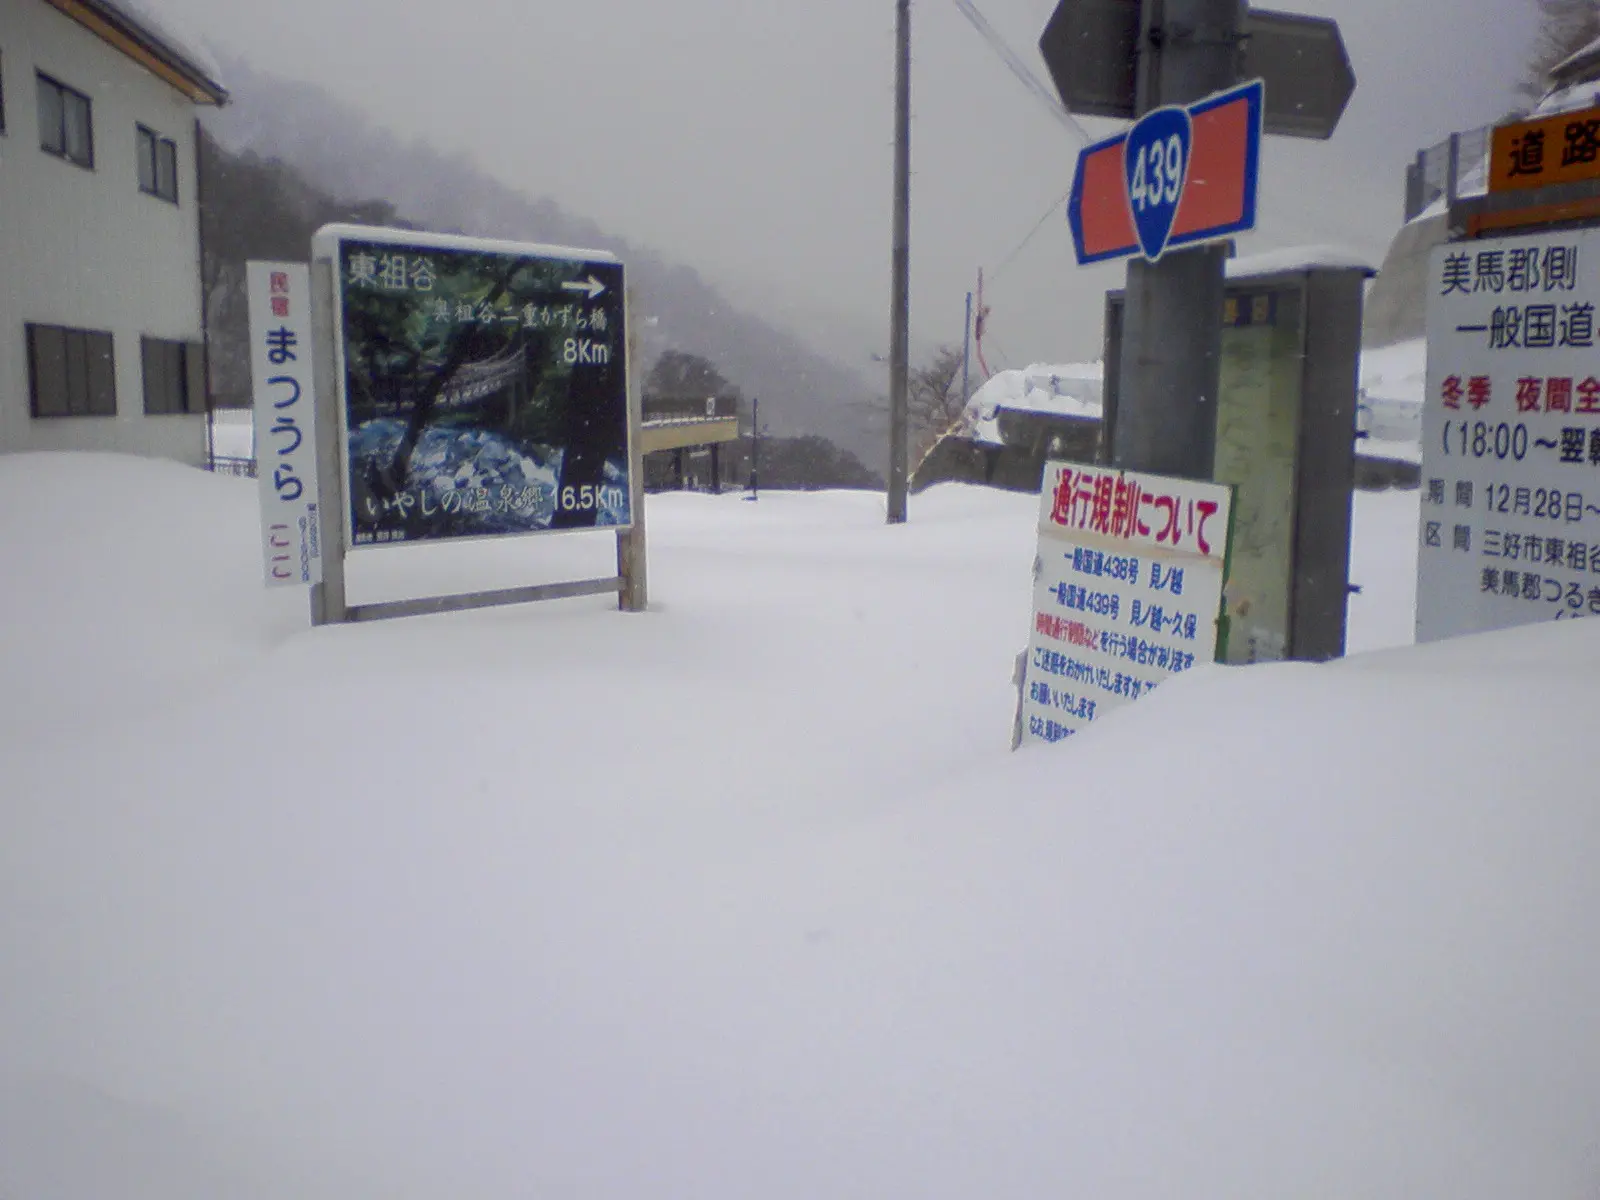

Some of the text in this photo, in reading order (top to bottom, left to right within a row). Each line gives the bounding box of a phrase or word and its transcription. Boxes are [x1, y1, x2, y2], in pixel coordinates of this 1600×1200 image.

[1132, 133, 1182, 211] 439
[1507, 119, 1600, 178] 道路
[349, 253, 436, 291] 東祖谷
[1441, 246, 1577, 295] 美馬郡側
[1455, 301, 1596, 349] 一般国道
[563, 338, 609, 364] 8Km
[265, 325, 303, 501] まつうら
[1442, 374, 1600, 414] 冬季 夜間全
[365, 484, 544, 518] いやしの温泉郷
[552, 484, 624, 512] 16.5Km
[1050, 468, 1219, 556] 通行規制について
[270, 523, 291, 578] ここ
[1064, 547, 1185, 596] 一般国道438号 見ノ越
[1048, 581, 1119, 621] 一般国道439号
